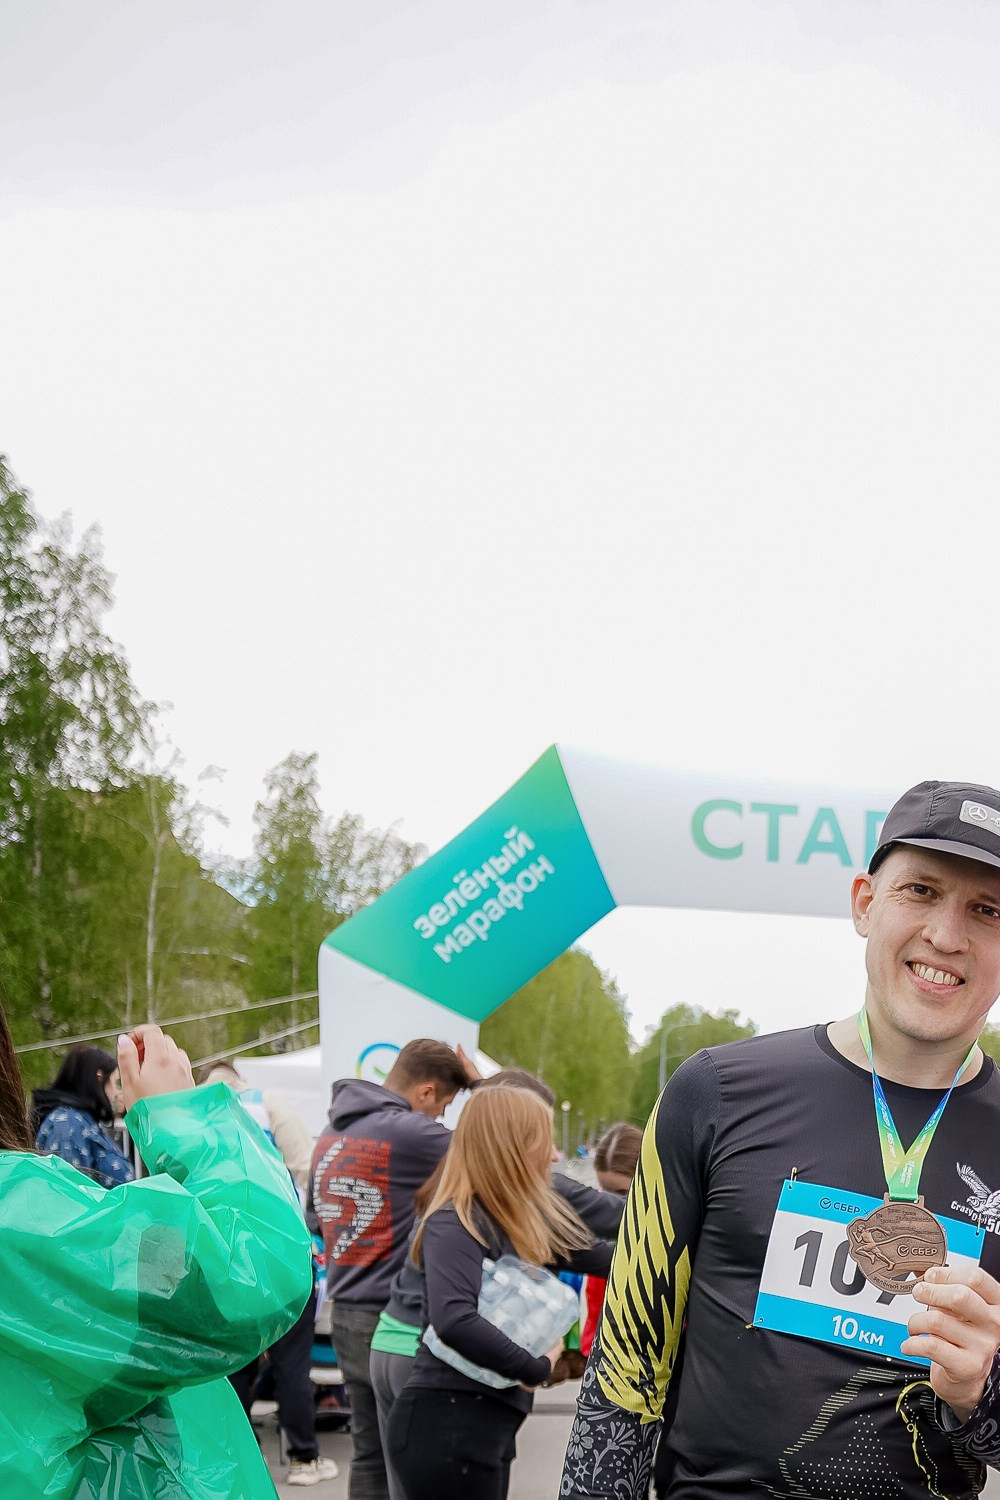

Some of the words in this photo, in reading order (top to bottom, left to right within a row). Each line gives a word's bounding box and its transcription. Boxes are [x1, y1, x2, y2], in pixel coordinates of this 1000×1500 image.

[413, 824, 536, 939] зелёный
[432, 855, 556, 963] марафон
[833, 1201, 861, 1214] СБЕР
[911, 1246, 938, 1257] СБЕР
